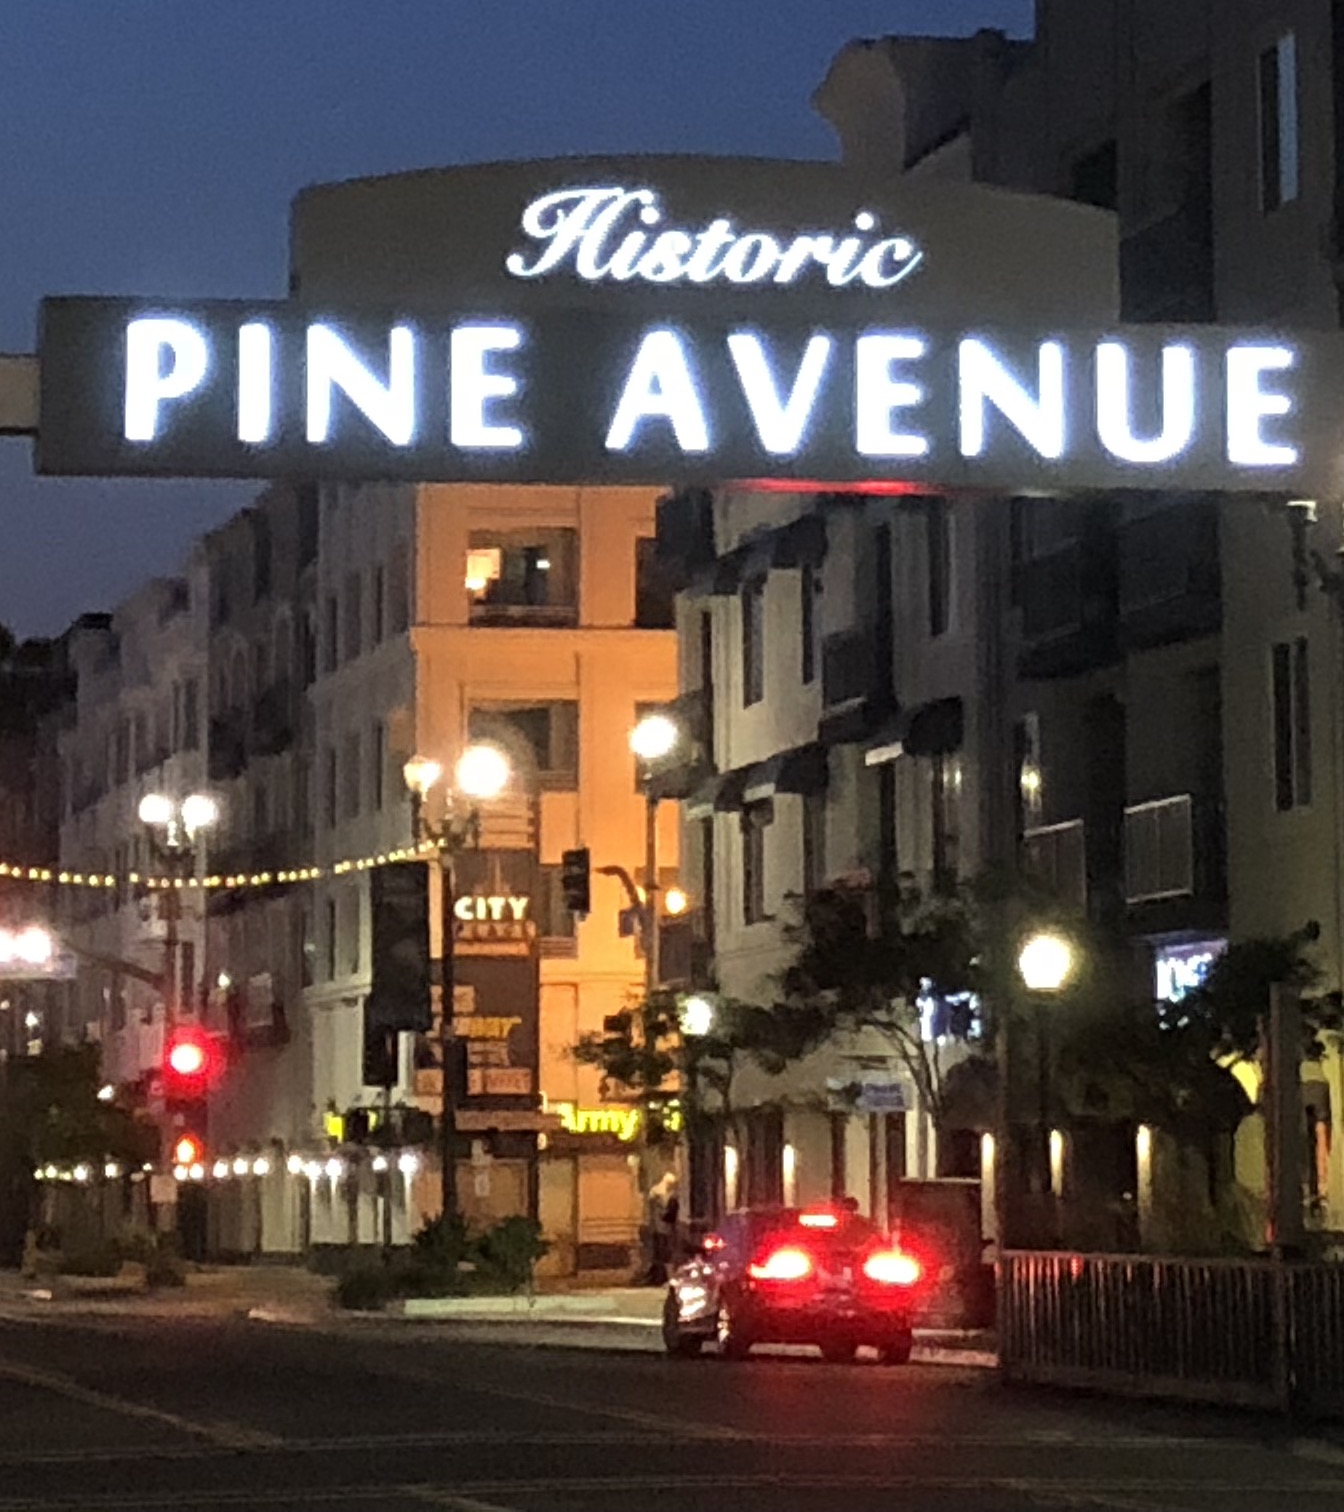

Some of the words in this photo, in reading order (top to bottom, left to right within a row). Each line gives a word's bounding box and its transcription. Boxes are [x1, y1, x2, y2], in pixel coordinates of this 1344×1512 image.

[506, 186, 923, 288] Historic
[123, 315, 524, 449] PINE
[606, 328, 1302, 467] AVENUE
[454, 896, 529, 920] CITY
